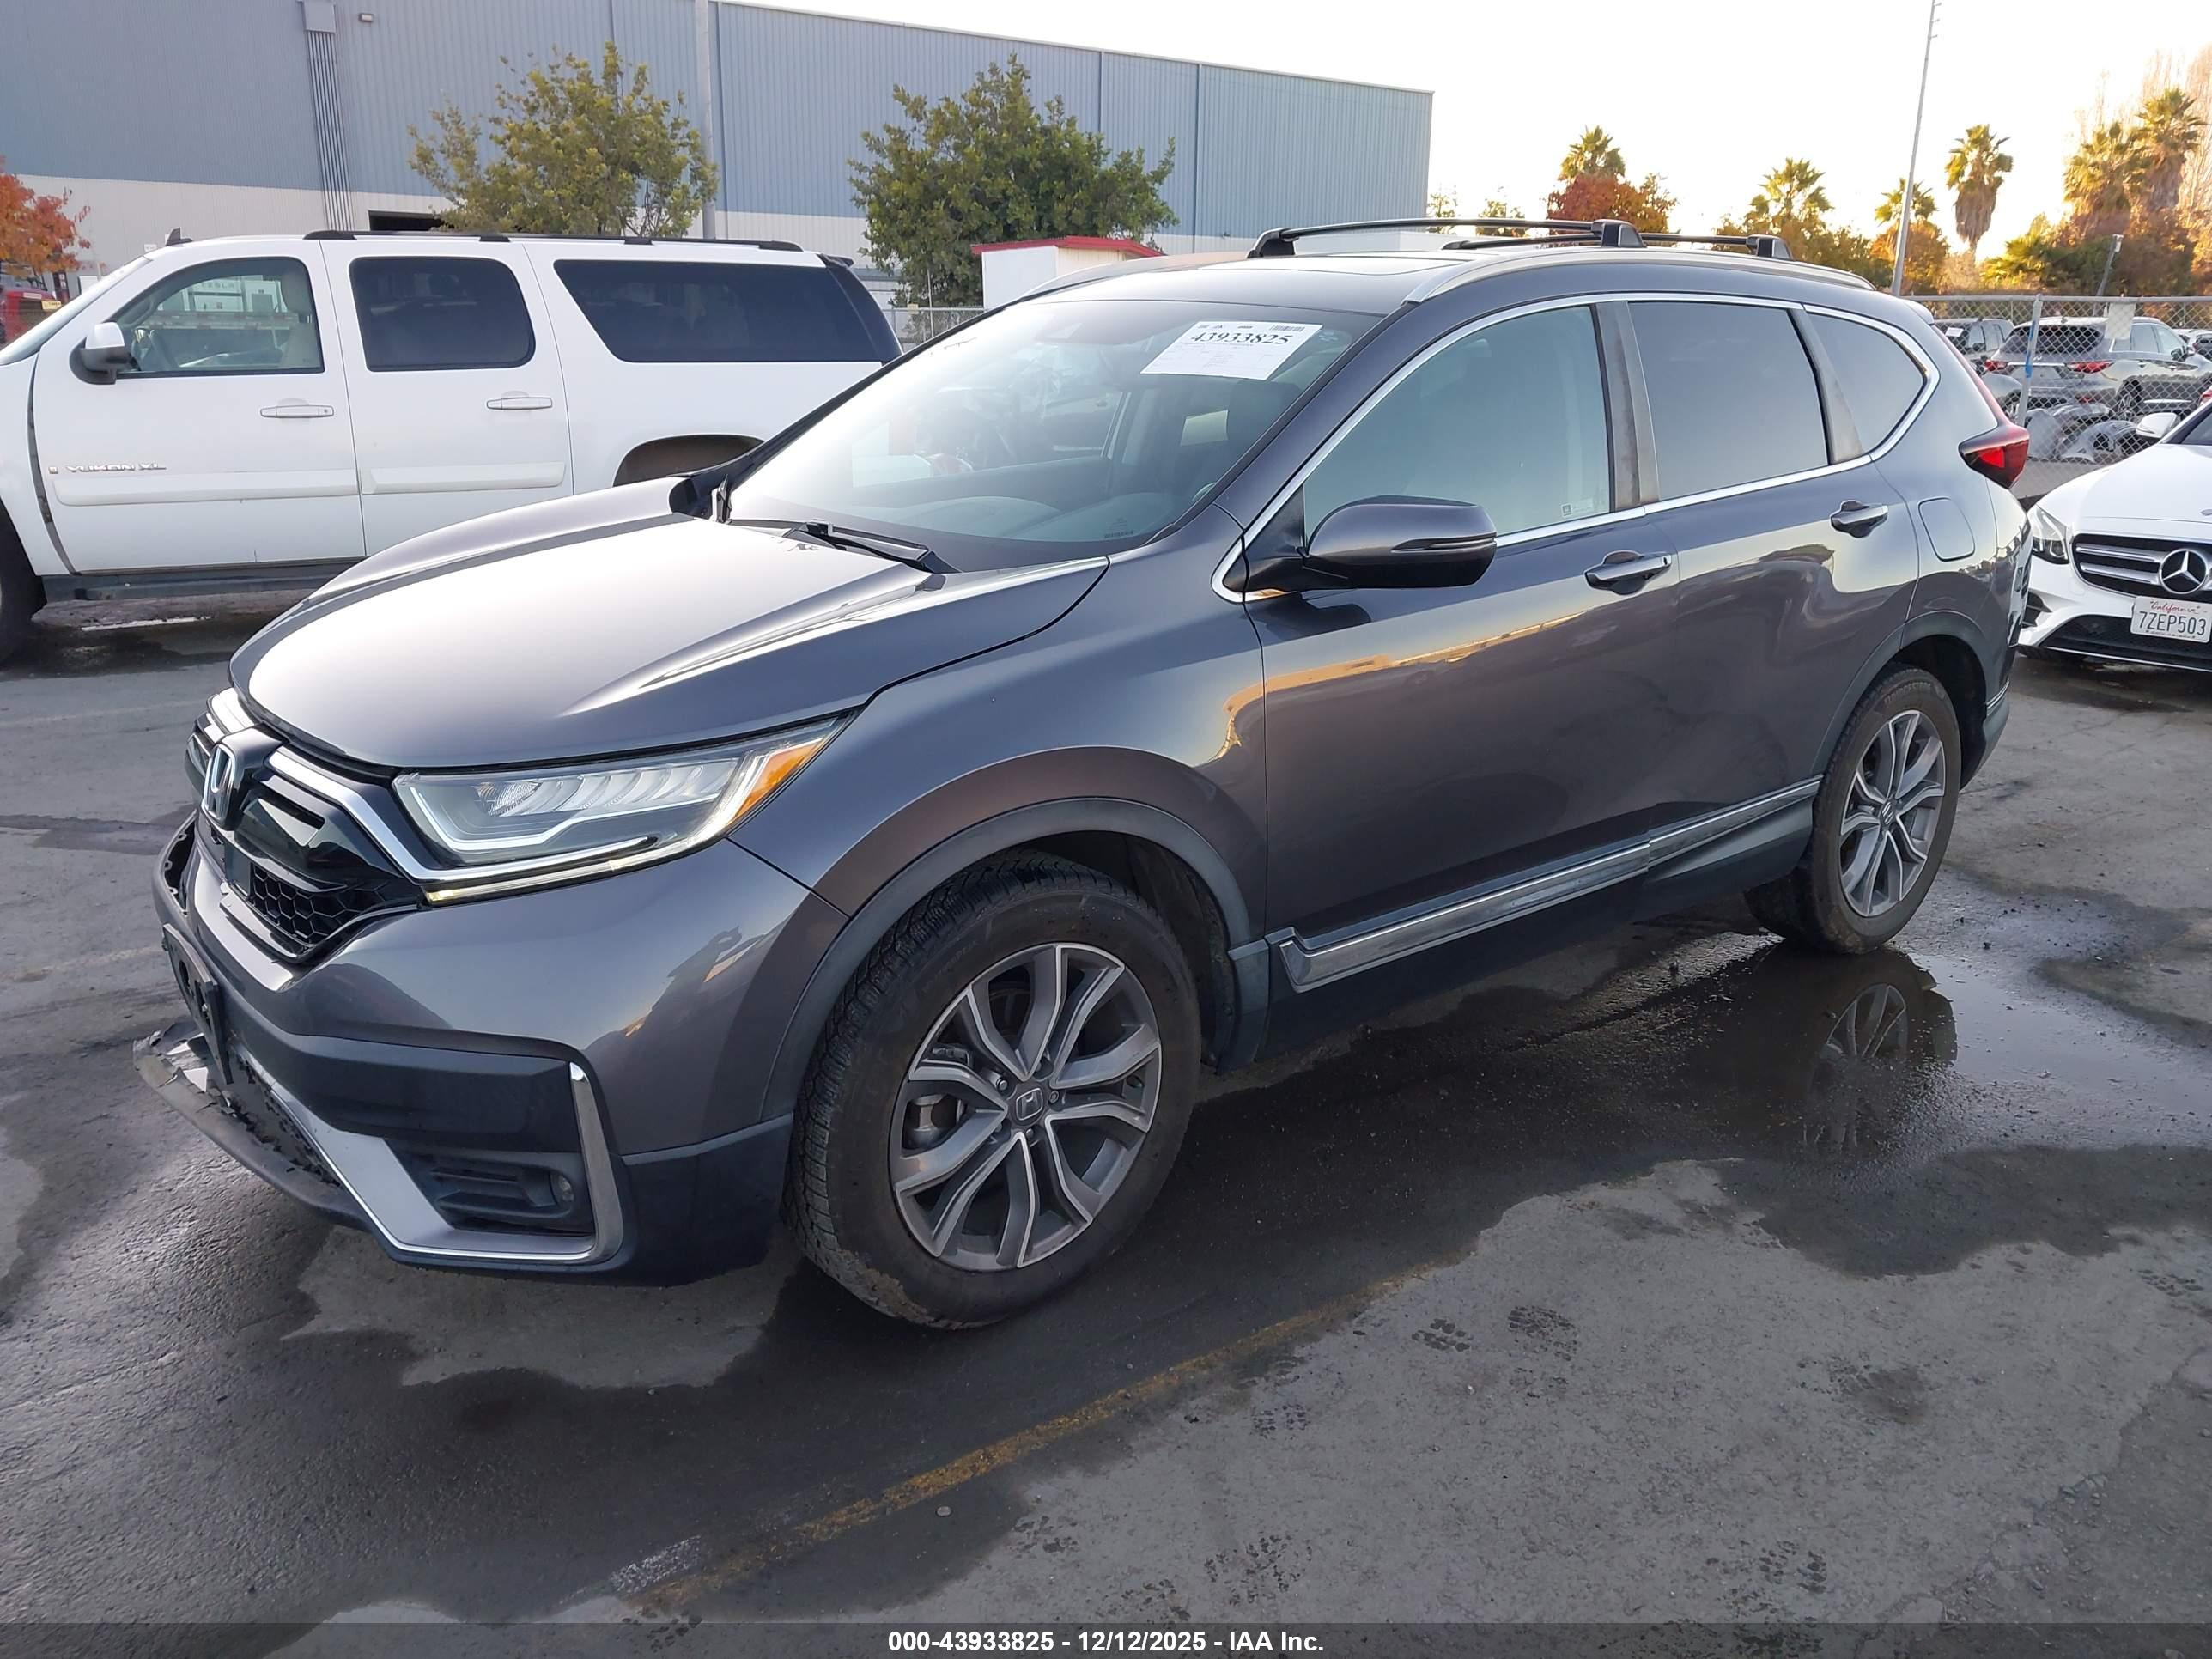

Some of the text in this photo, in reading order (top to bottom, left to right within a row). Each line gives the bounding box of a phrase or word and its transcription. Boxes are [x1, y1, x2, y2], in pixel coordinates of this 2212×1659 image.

[1190, 331, 1294, 345] 43933825
[66, 462, 167, 473] YUKON XL
[2150, 601, 2199, 615] California
[2139, 611, 2207, 636] 7ZEP503
